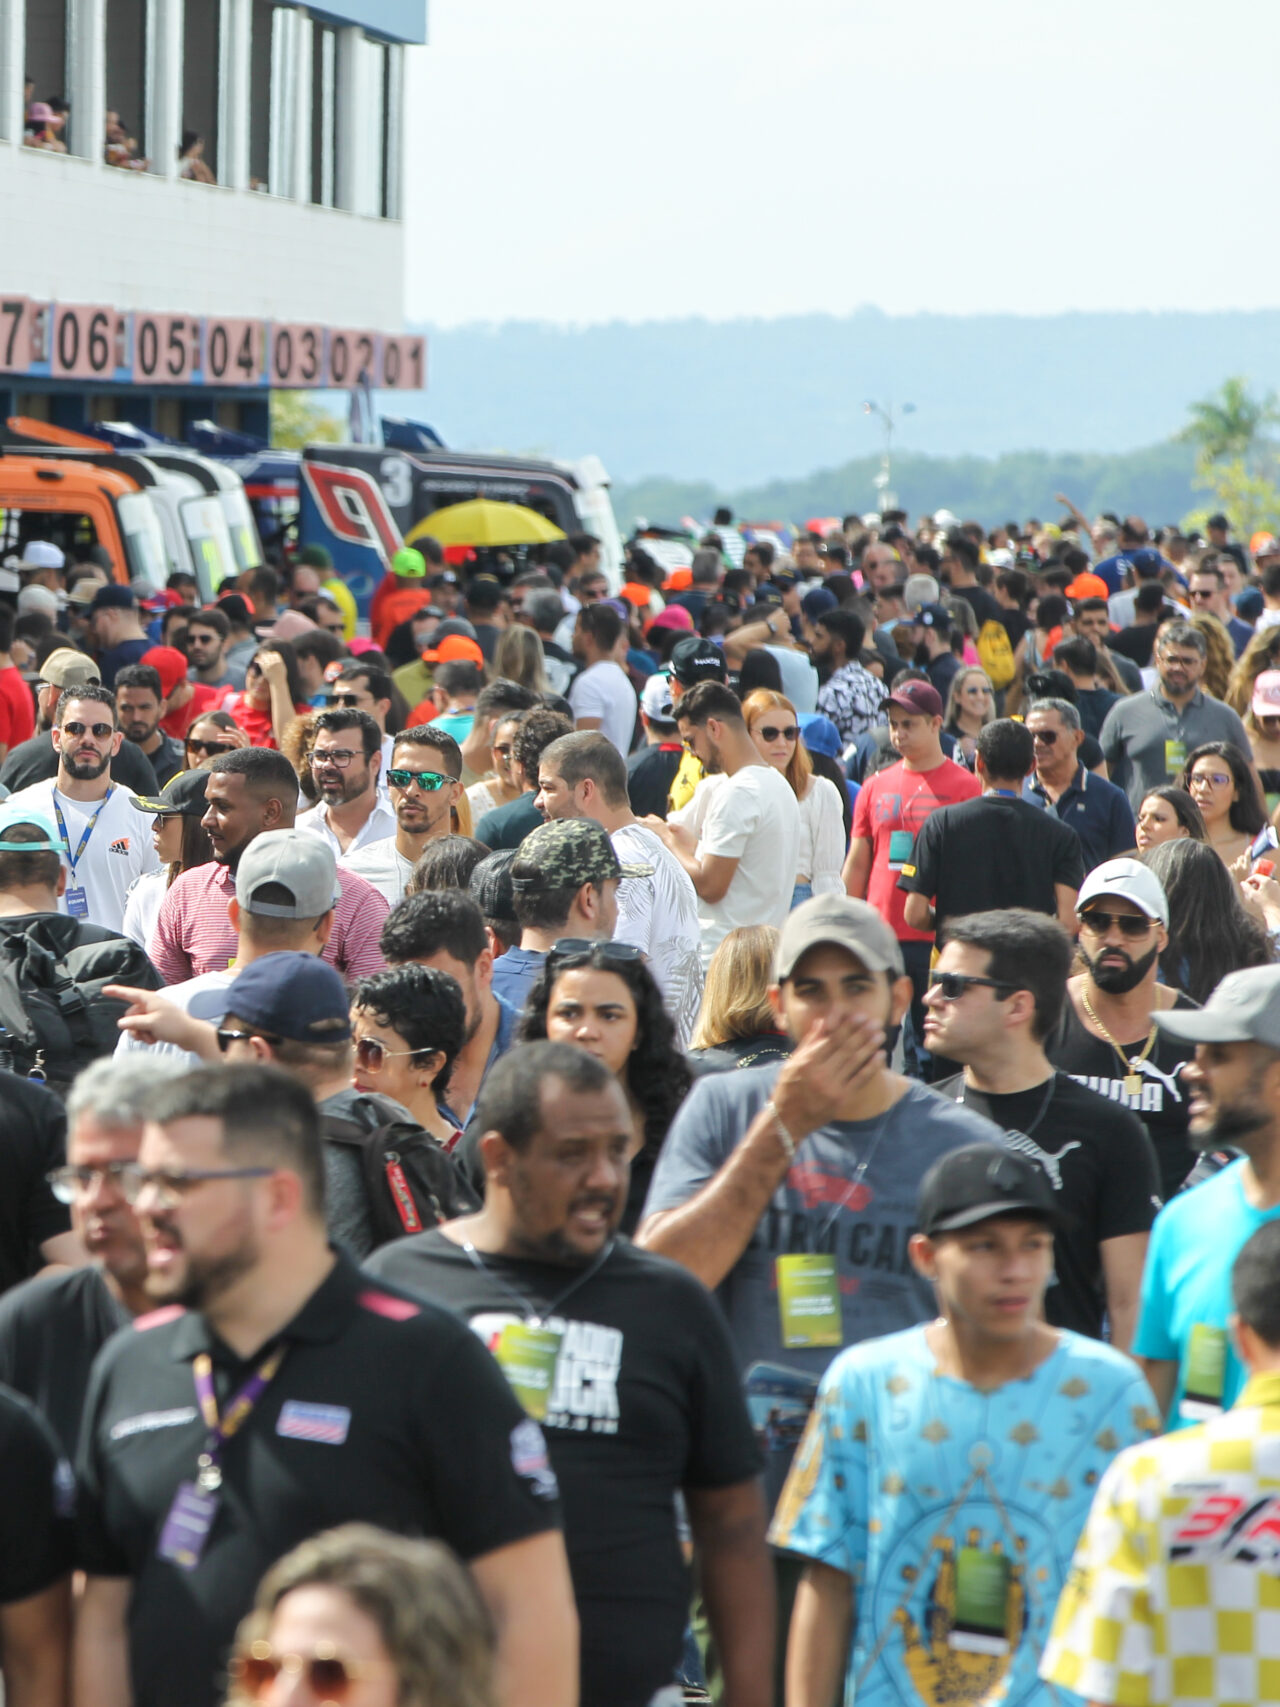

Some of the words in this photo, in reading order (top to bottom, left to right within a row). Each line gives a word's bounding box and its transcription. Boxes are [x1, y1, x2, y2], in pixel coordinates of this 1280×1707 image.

[58, 311, 109, 371] 06
[139, 320, 185, 376] 05
[209, 326, 254, 378] 04
[274, 330, 317, 379] 03
[383, 341, 420, 386] 01
[379, 456, 413, 507] 3
